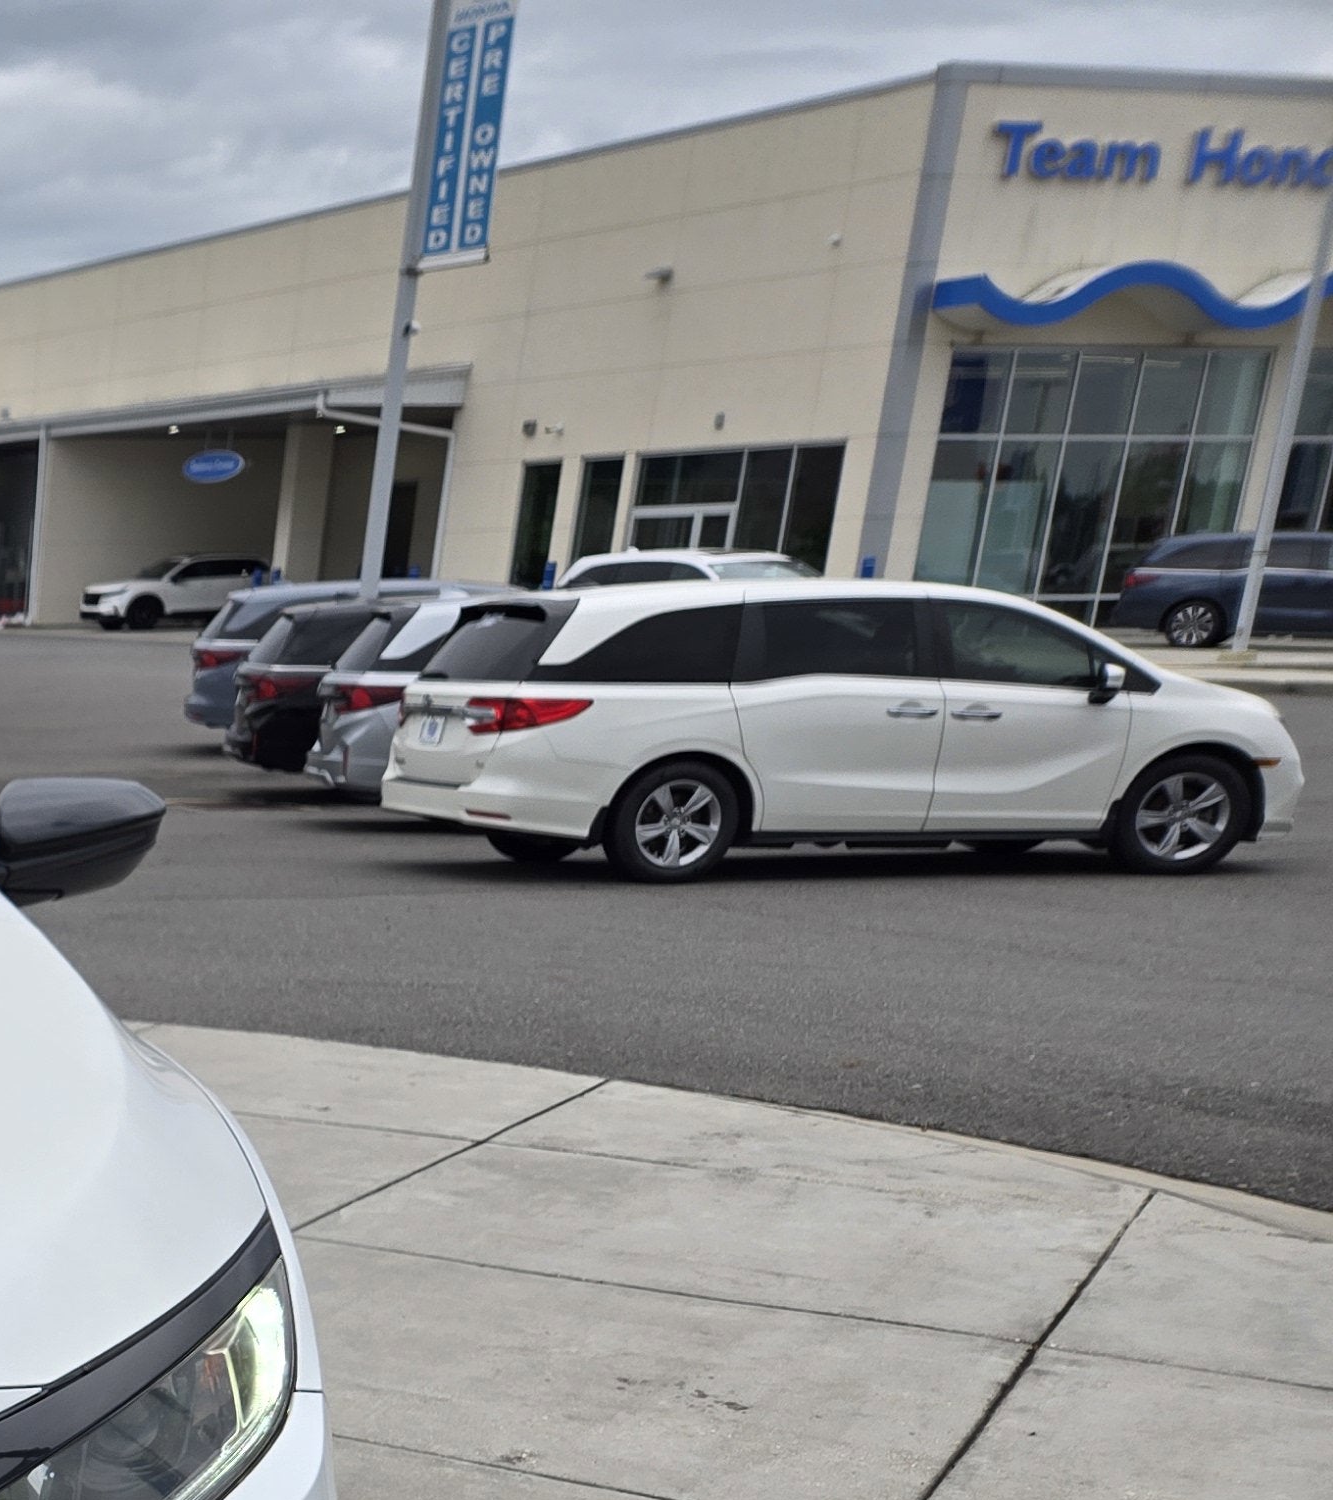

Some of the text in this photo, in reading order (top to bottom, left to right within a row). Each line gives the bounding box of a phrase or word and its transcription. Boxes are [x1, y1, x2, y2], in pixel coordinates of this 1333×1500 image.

[427, 31, 471, 249] CERTIFIED
[464, 22, 507, 244] PRE OWNED
[993, 120, 1161, 182] Team
